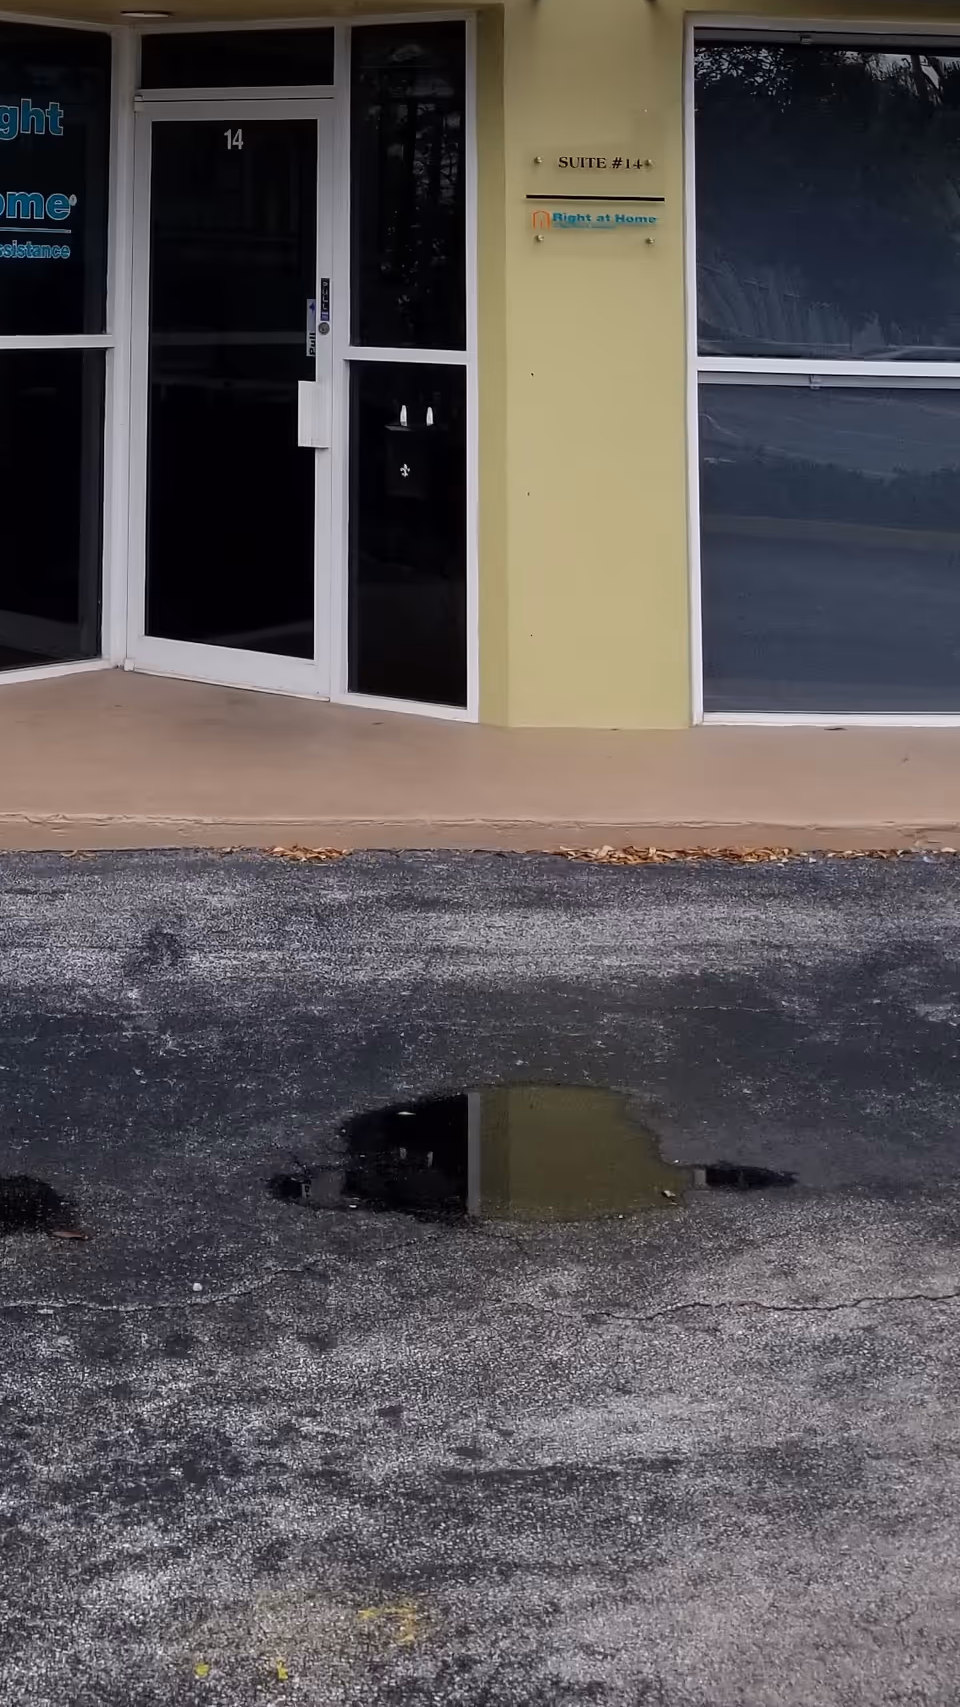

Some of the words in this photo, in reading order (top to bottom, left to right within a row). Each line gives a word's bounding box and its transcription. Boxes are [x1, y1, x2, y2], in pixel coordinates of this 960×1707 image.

[224, 129, 243, 149] 14
[558, 156, 607, 169] SUITE
[612, 156, 643, 170] #14
[552, 212, 592, 223] Right
[596, 213, 611, 222] at
[614, 214, 657, 224] Home
